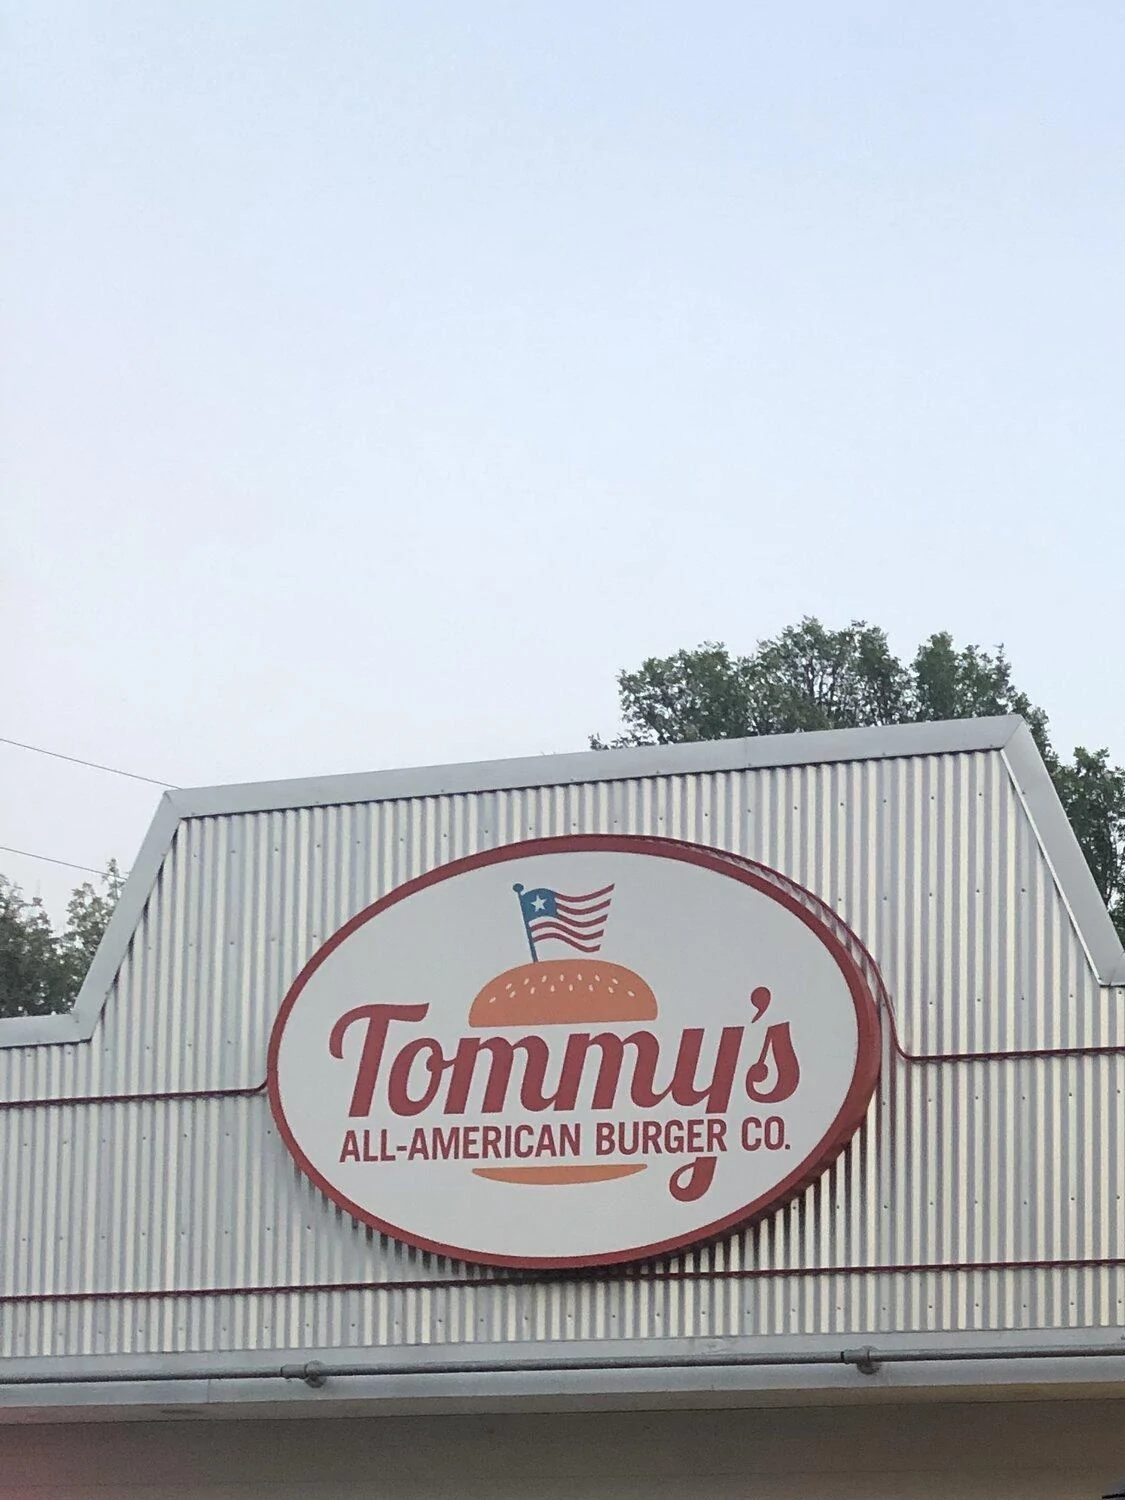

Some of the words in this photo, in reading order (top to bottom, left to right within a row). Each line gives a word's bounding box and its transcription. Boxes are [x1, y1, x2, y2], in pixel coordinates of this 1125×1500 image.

[329, 986, 801, 1203] Tommy's
[339, 1123, 581, 1164] ALL-AMERICAN
[596, 1117, 728, 1157] BURGER
[740, 1115, 791, 1152] CO.
